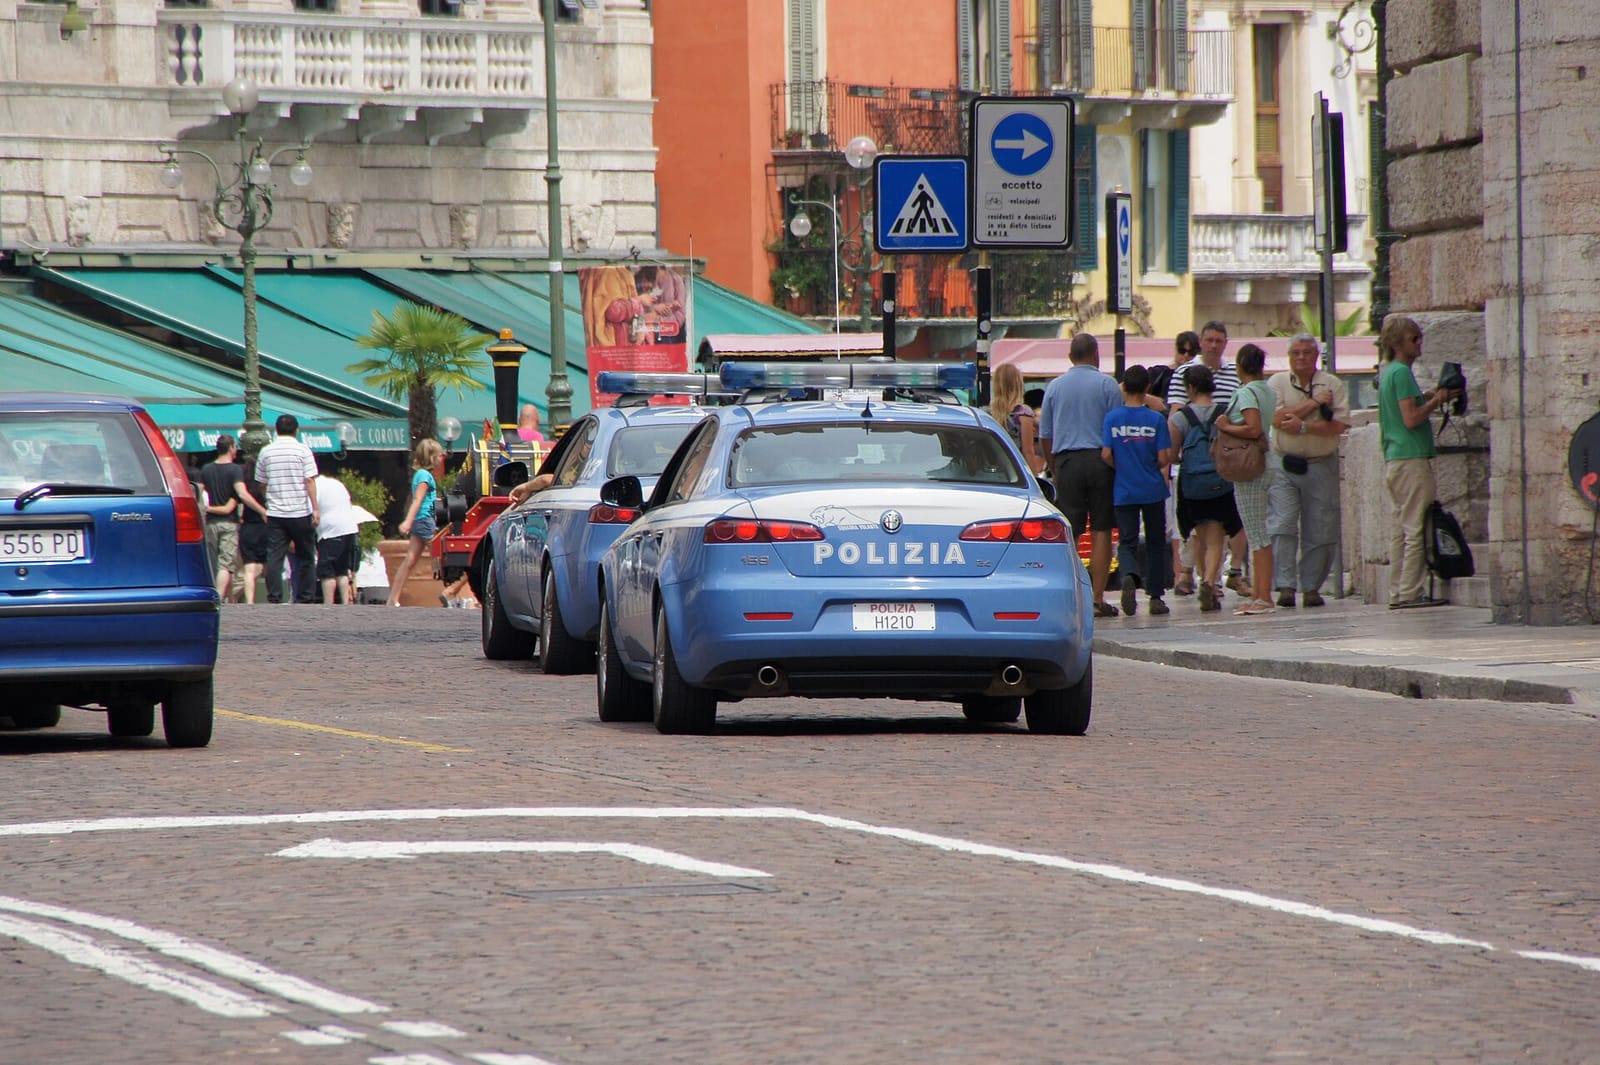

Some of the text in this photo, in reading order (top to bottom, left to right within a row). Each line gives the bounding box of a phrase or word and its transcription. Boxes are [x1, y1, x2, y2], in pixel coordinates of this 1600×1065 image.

[1001, 181, 1042, 190] eccetto
[1111, 425, 1157, 439] NCC
[110, 511, 141, 521] Punto
[3, 532, 79, 555] 556 PD
[813, 542, 966, 565] POLIZIA
[870, 603, 917, 614] POLIZIA
[874, 615, 915, 630] H1210
